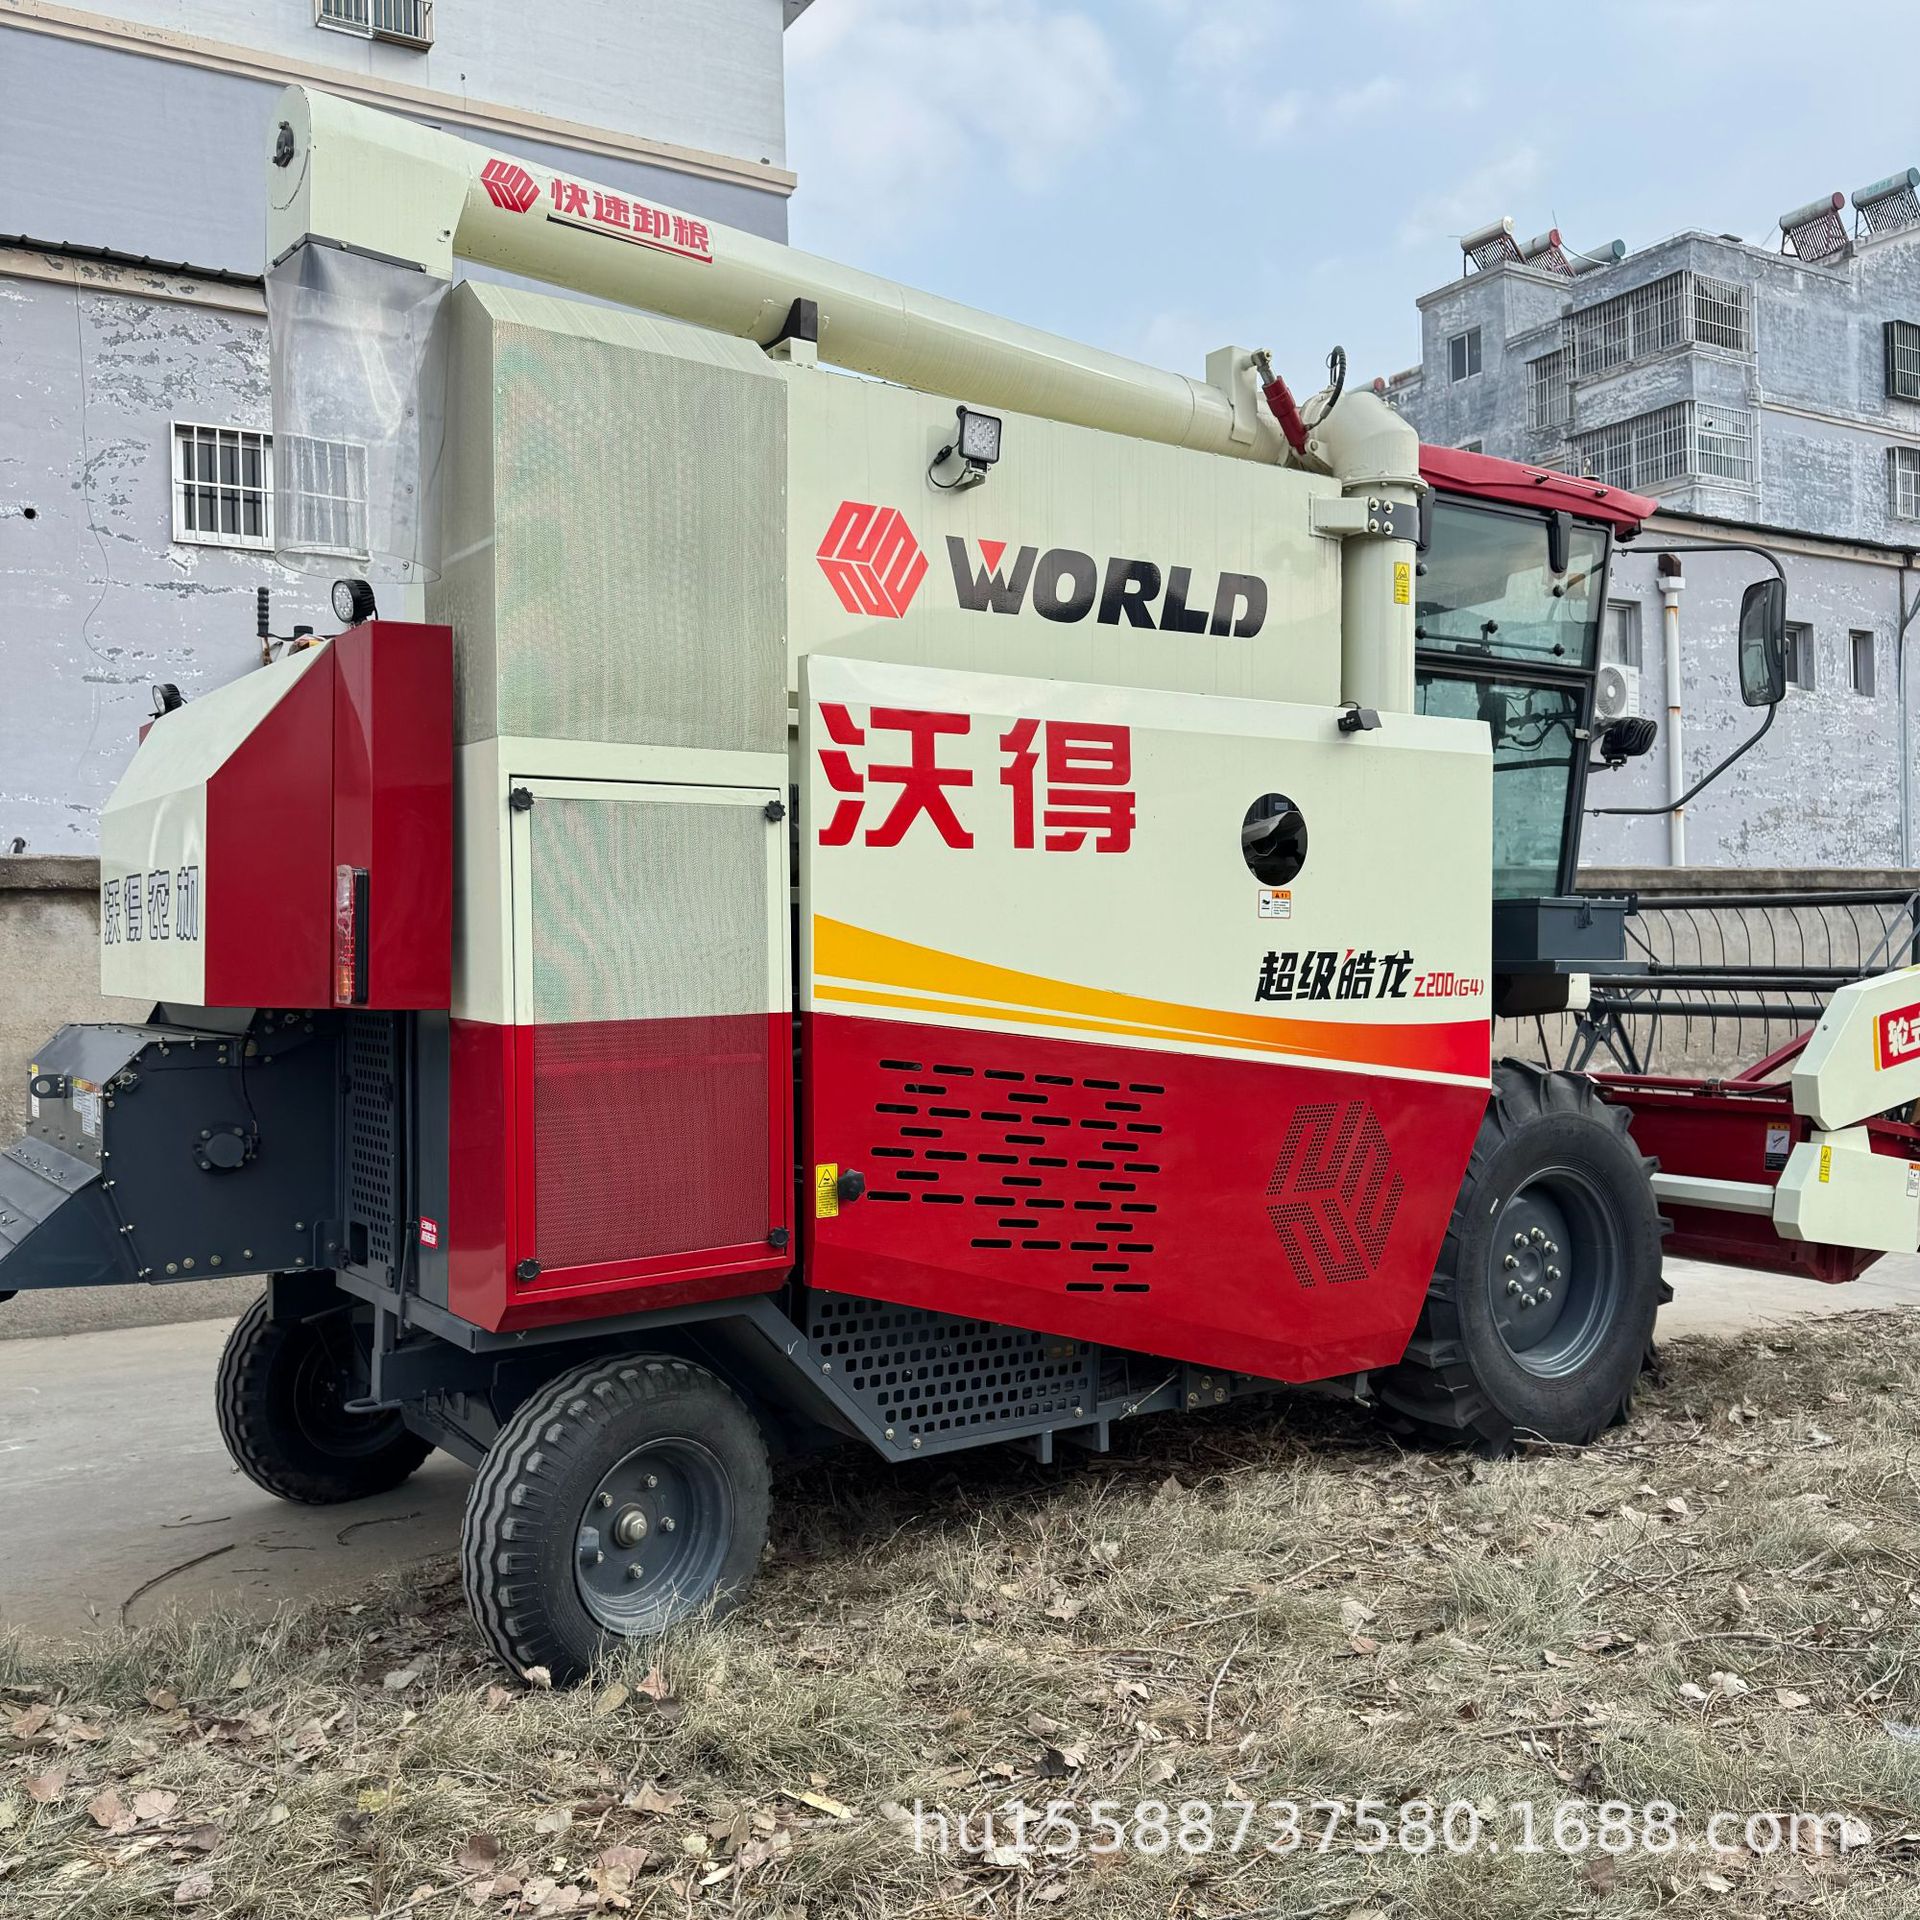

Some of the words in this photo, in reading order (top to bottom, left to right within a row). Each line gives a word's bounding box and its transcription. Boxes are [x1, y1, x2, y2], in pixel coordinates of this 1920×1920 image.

[550, 177, 710, 253] 快速卸粮
[945, 535, 1269, 639] WORLD
[817, 701, 1137, 854] 沃得
[1254, 948, 1415, 1002] 超级皓龙
[1413, 972, 1485, 998] Z200(G4)
